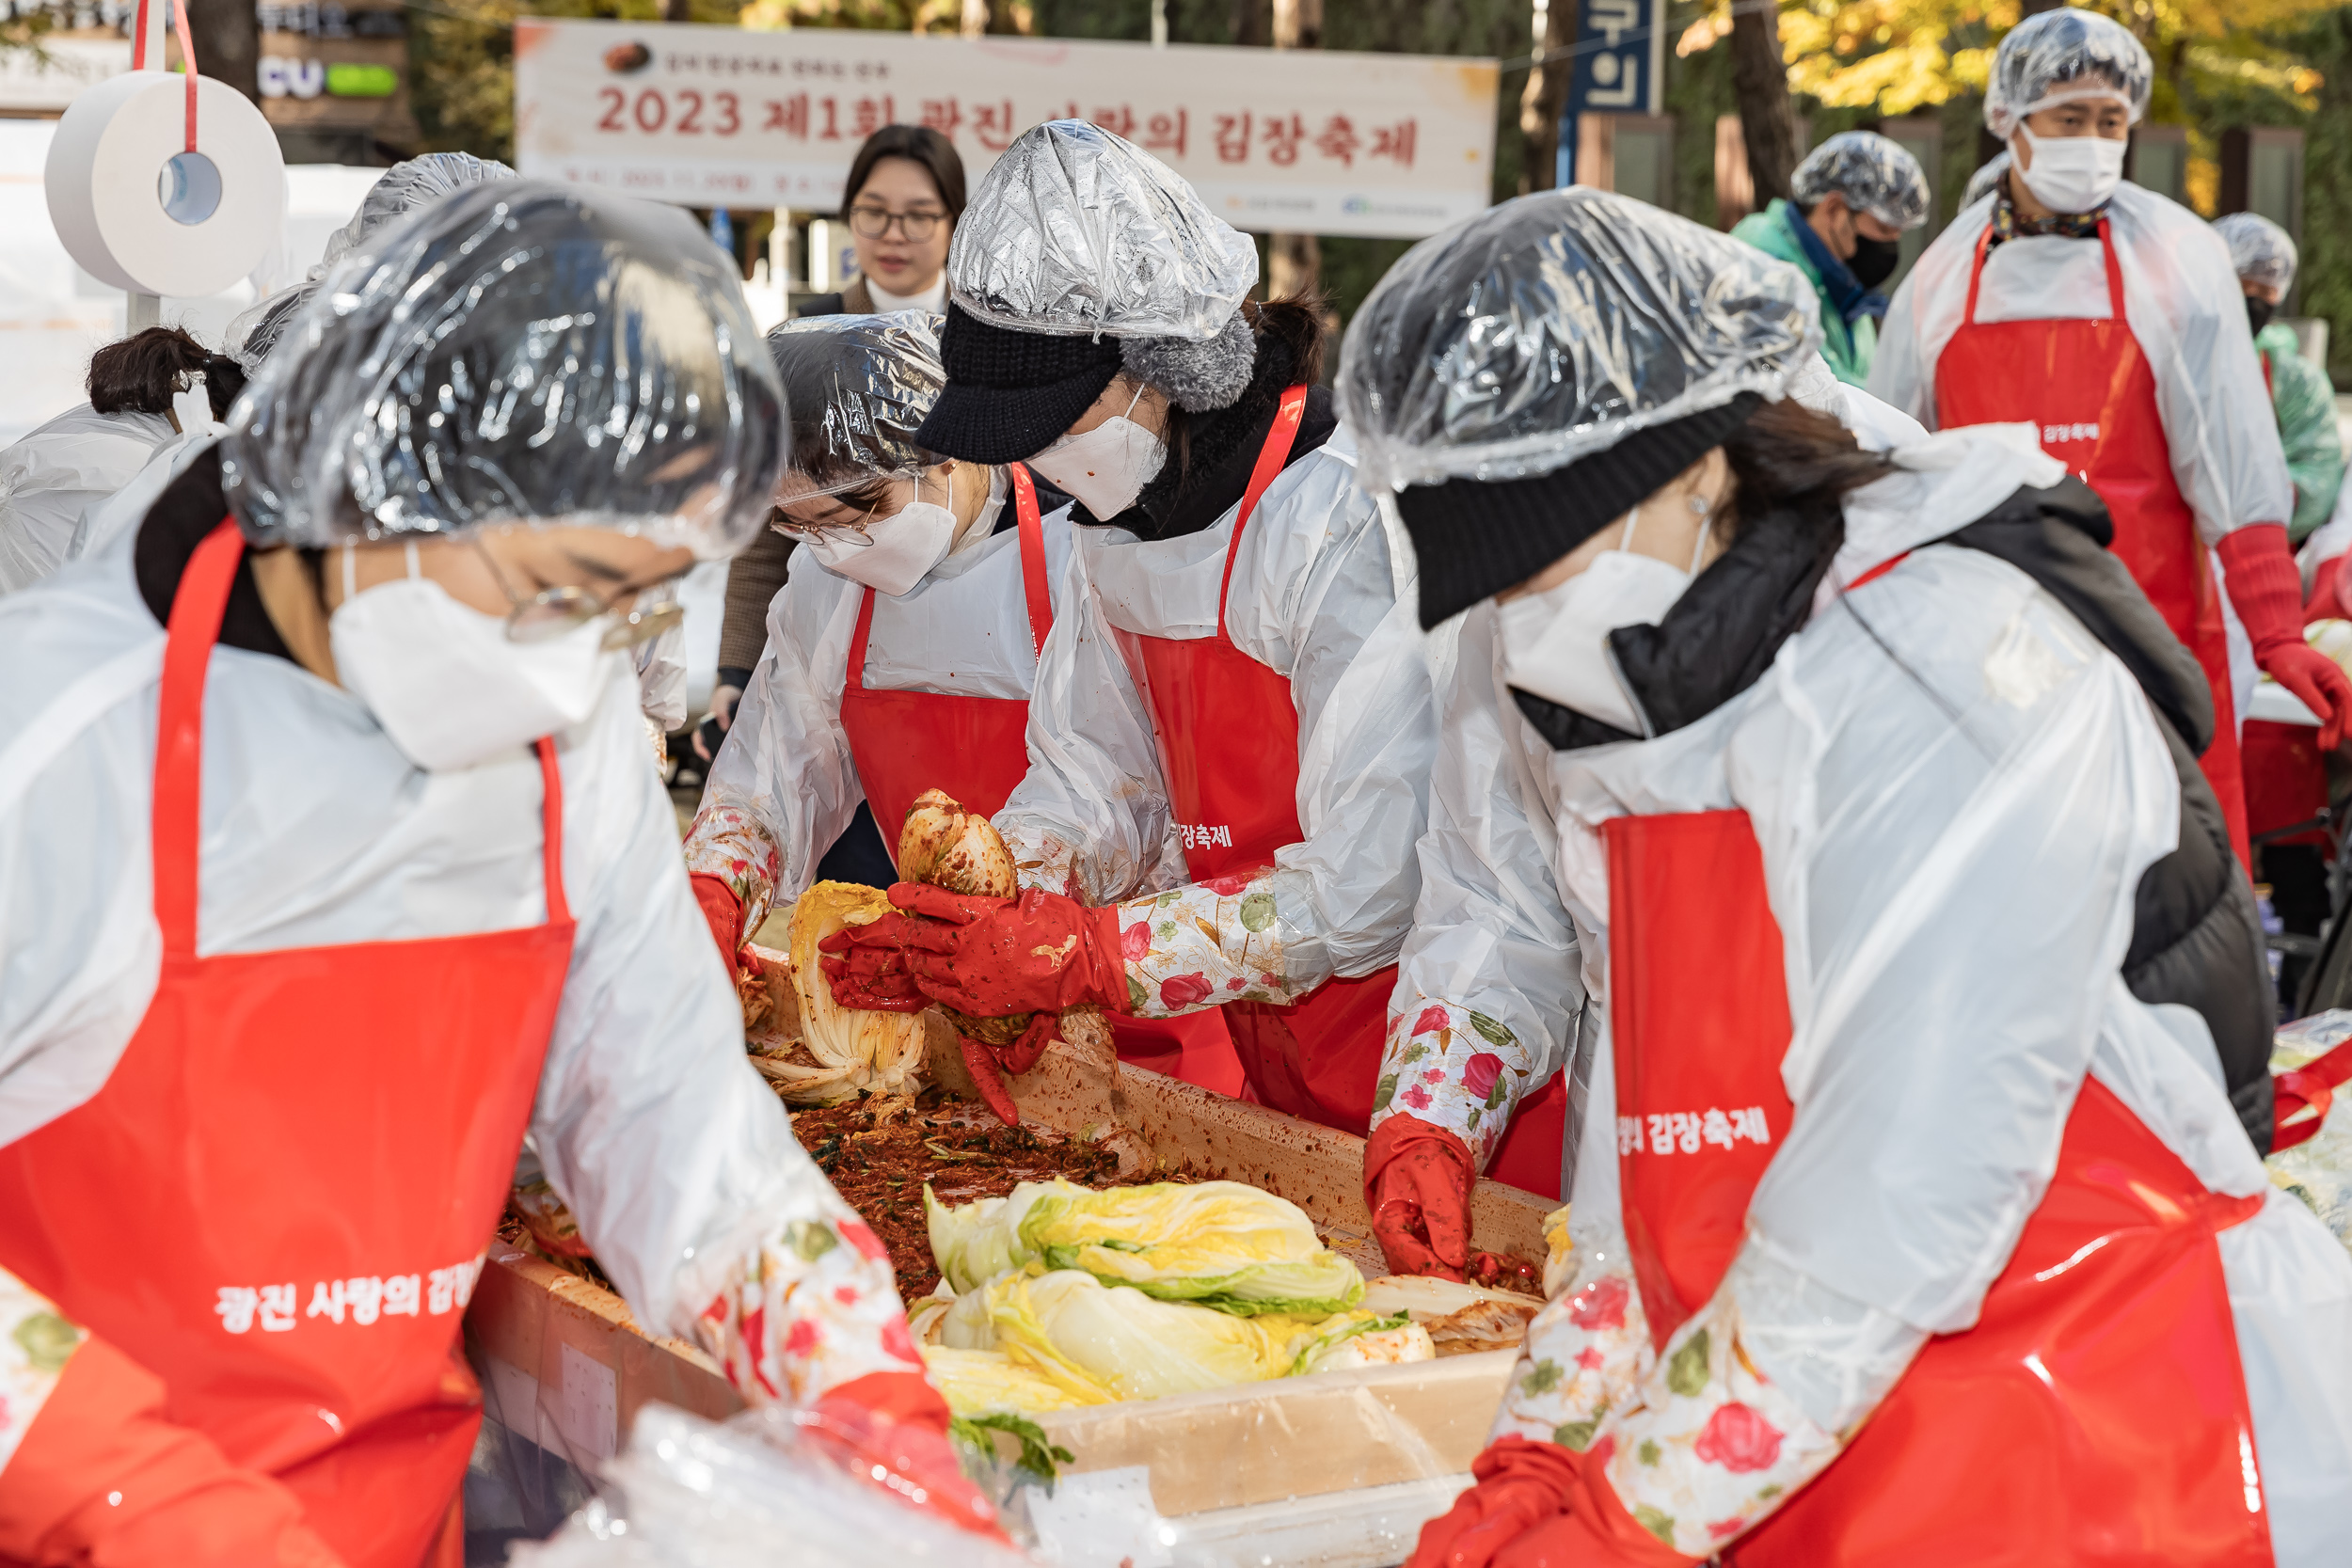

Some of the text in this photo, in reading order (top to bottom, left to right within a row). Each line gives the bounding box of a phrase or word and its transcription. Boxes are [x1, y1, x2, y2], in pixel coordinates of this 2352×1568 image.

[257, 55, 324, 100] CU
[596, 86, 742, 137] 2023
[761, 91, 897, 144] 제1회
[1214, 105, 1419, 169] 김장축제
[1178, 823, 1233, 850] 장축제
[1646, 1106, 1771, 1155] 김장축제
[215, 1283, 297, 1335] 광진
[306, 1273, 421, 1326] 사랑의
